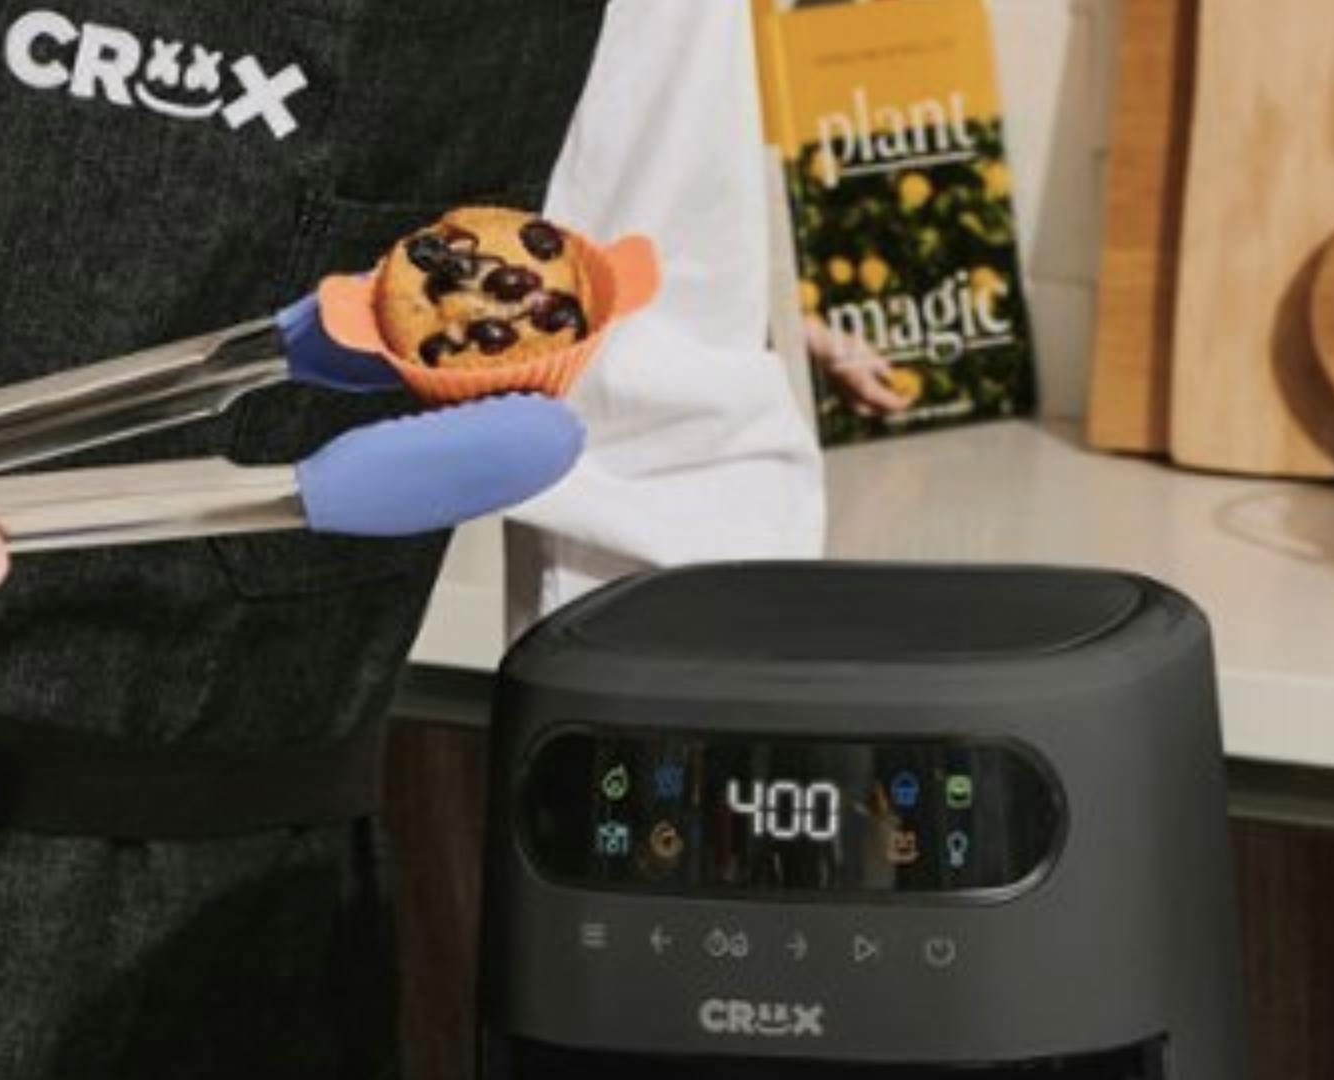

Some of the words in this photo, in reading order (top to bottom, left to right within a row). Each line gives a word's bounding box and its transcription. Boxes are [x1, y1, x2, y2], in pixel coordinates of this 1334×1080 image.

[816, 86, 977, 190] plant
[829, 270, 1010, 364] magic
[727, 778, 840, 841] 400
